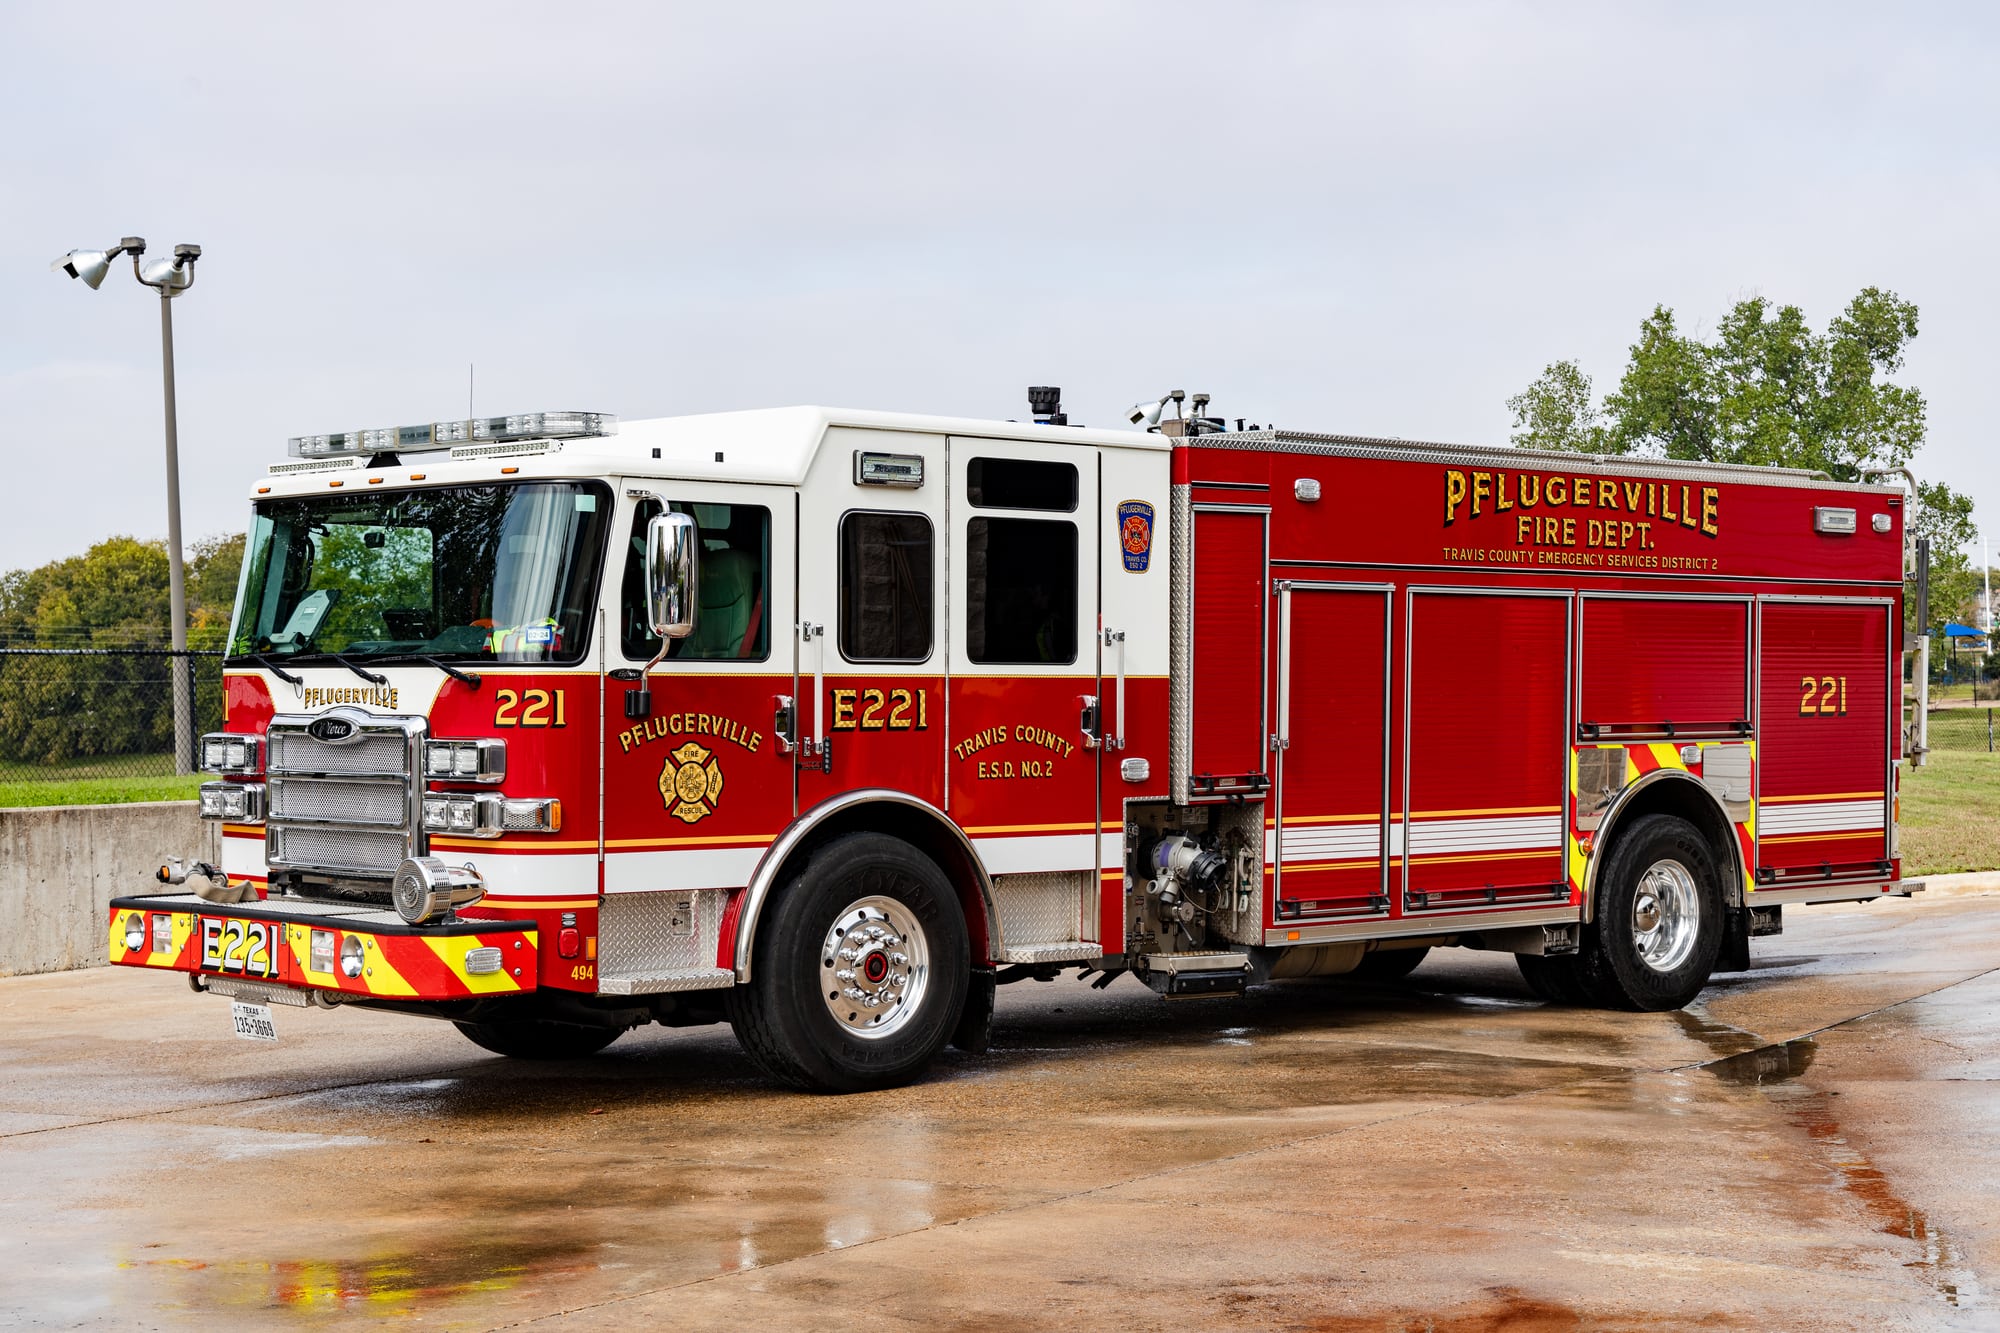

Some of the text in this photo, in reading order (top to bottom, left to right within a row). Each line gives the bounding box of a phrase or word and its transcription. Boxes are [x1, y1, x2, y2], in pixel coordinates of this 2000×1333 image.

[1120, 504, 1152, 516] PFLUGERVILLE
[1444, 470, 1719, 537] PFLUGERVILLE
[1516, 515, 1655, 549] FIRE DEPT.
[1443, 547, 1718, 570] TRAVIS COUNTY EMERGENCY SERVICES DISTRICT 2
[304, 687, 399, 710] PFLUGERVILLE
[1799, 676, 1847, 716] 221
[495, 688, 567, 728] 221
[831, 688, 928, 731] E221
[317, 720, 347, 737] Pierce
[618, 713, 763, 753] PFLUGERVILLE
[683, 750, 699, 758] FIRE
[954, 725, 1074, 760] TRAVIS COUNTY
[978, 761, 1016, 778] E.S.D.
[679, 807, 703, 815] RESCUE
[201, 918, 279, 978] E221
[571, 965, 594, 980] 494
[242, 1005, 260, 1016] TEXAS
